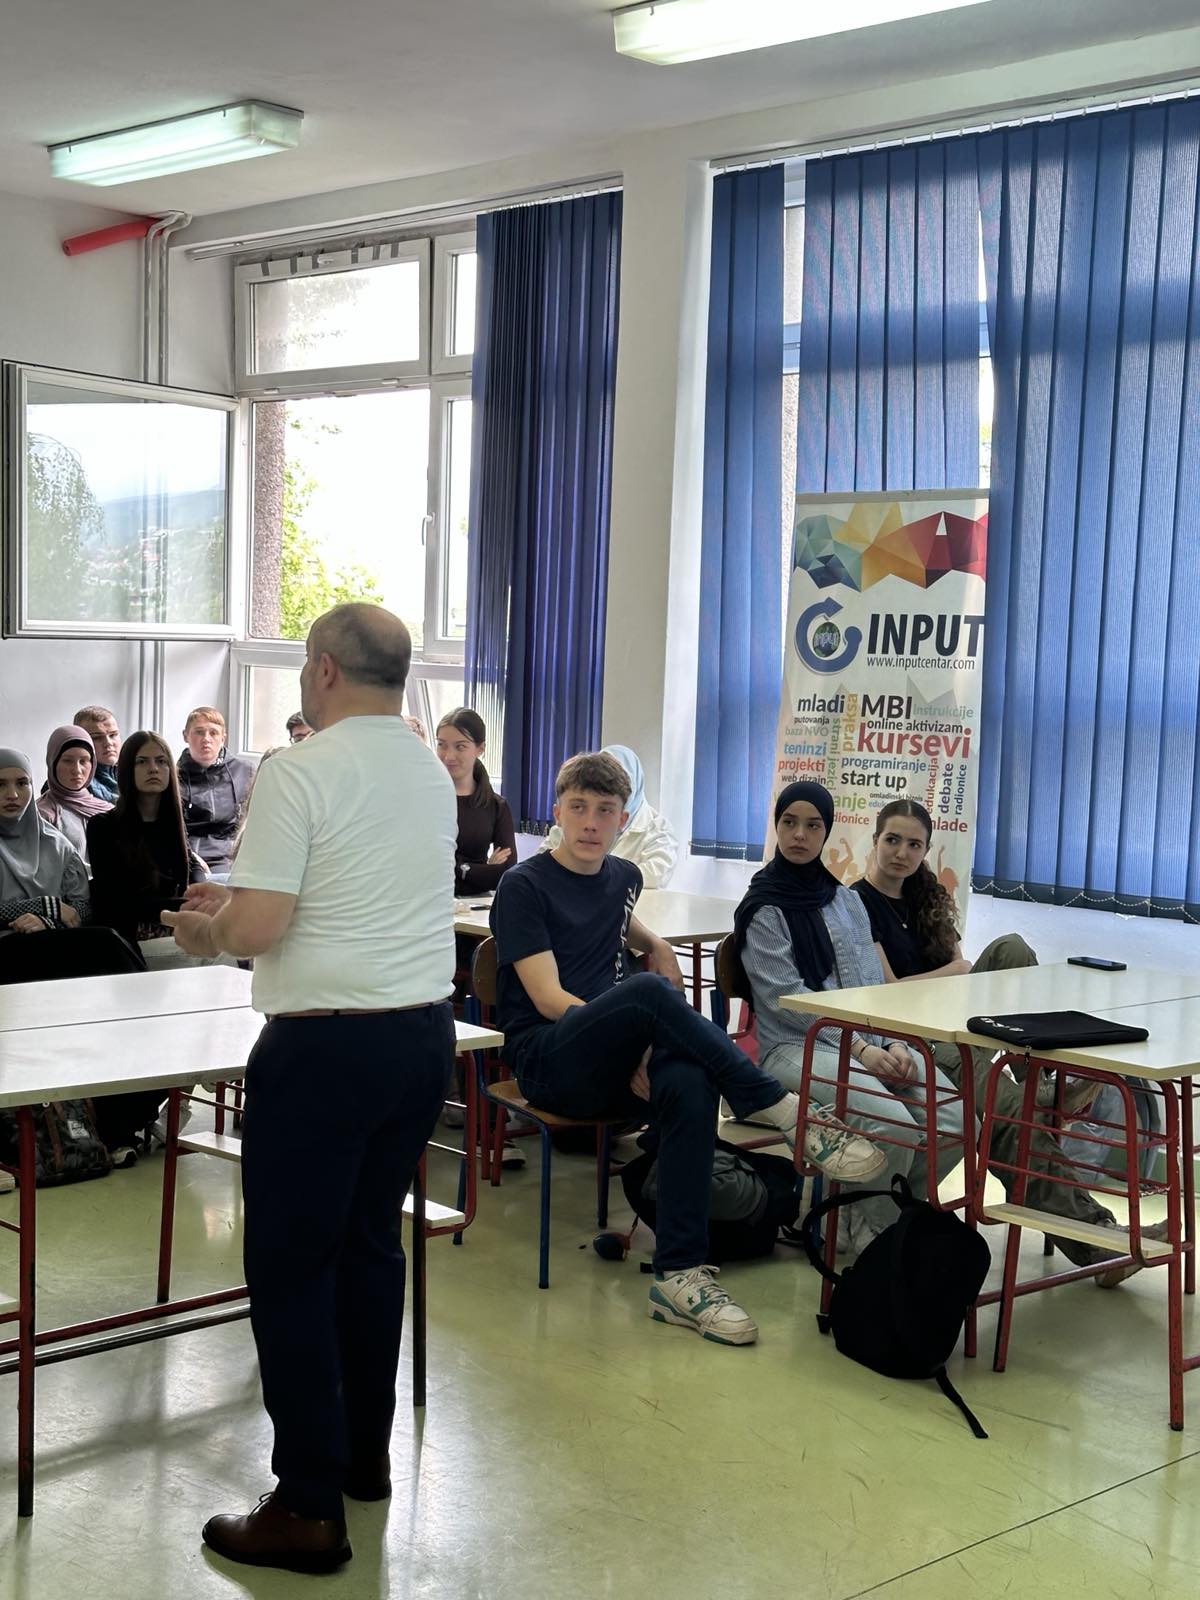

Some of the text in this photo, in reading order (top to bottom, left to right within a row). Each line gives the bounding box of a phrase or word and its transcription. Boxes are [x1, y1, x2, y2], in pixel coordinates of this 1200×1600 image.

[867, 614, 984, 657] INPUT
[867, 656, 975, 670] www.inputcentar.com
[797, 693, 845, 713] mladi
[861, 694, 912, 719] MBI
[794, 716, 830, 725] putovanja
[804, 726, 829, 736] NVO
[843, 693, 858, 752] praksa
[867, 718, 963, 733] online aktivizam
[857, 722, 971, 758] kursevi
[826, 717, 841, 790] strani jezici
[778, 757, 826, 773] projekti
[841, 757, 927, 773] programiranje
[781, 773, 797, 782] web
[841, 770, 907, 792] start up
[925, 758, 939, 814] edukacija
[938, 763, 954, 813] debate
[954, 764, 967, 815] radionice
